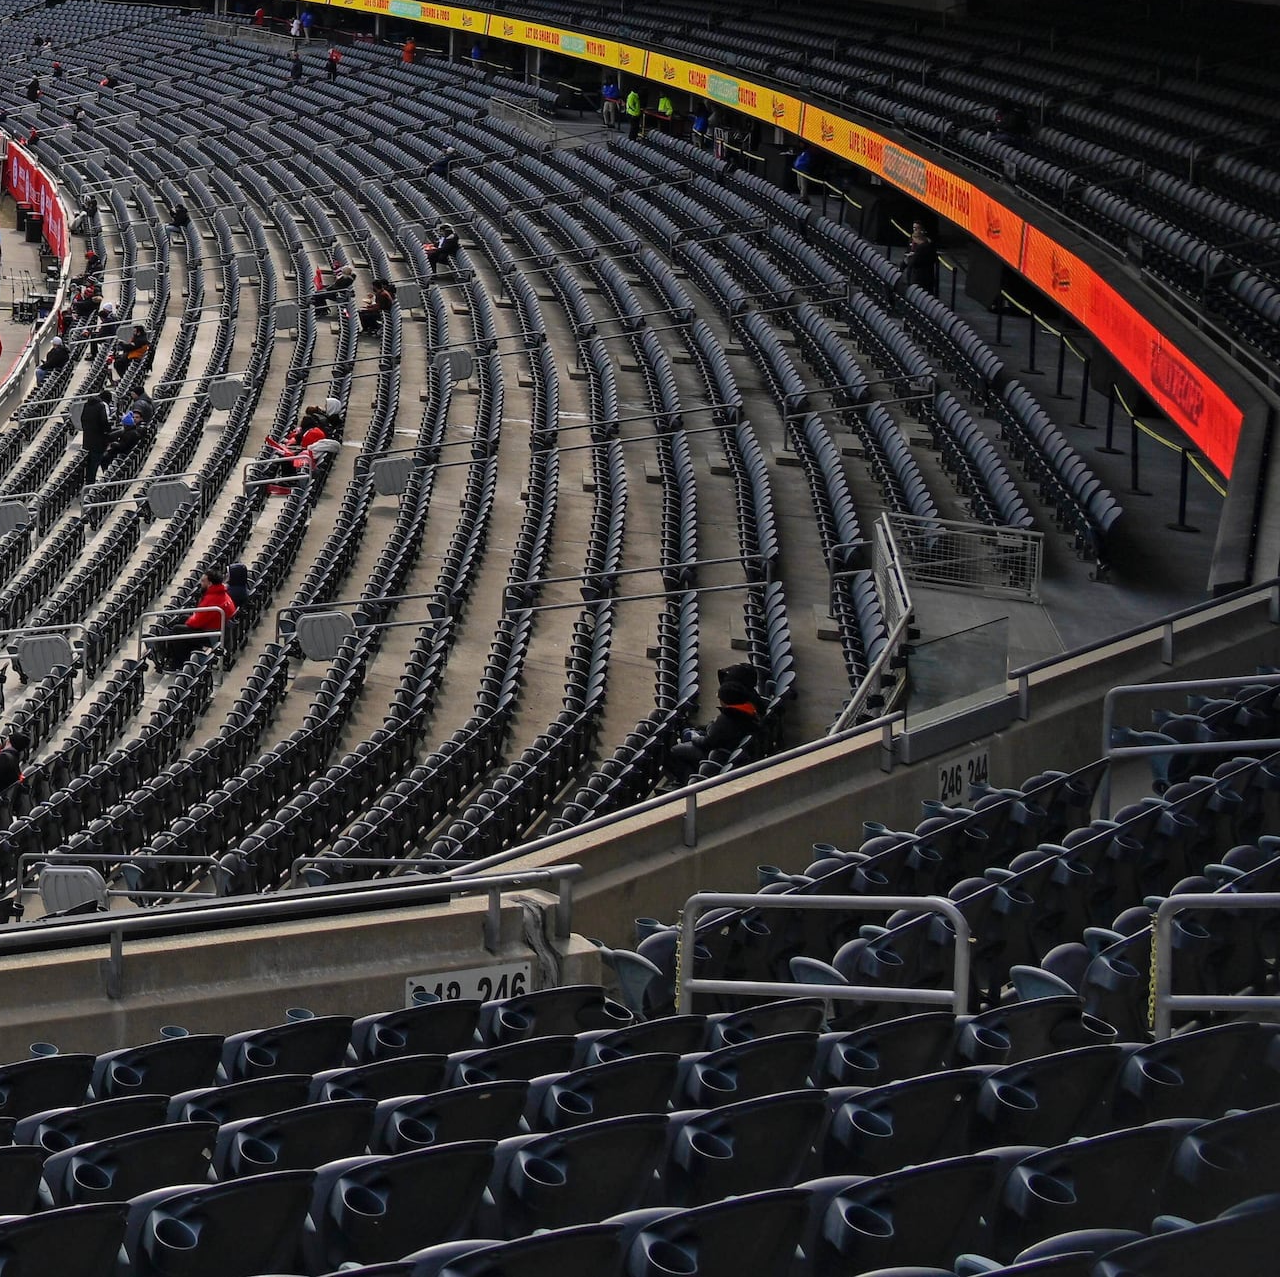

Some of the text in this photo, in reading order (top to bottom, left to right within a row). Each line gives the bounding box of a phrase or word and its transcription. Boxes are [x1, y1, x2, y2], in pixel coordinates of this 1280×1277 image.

[941, 753, 988, 801] 246 244
[477, 972, 526, 1001] 246
